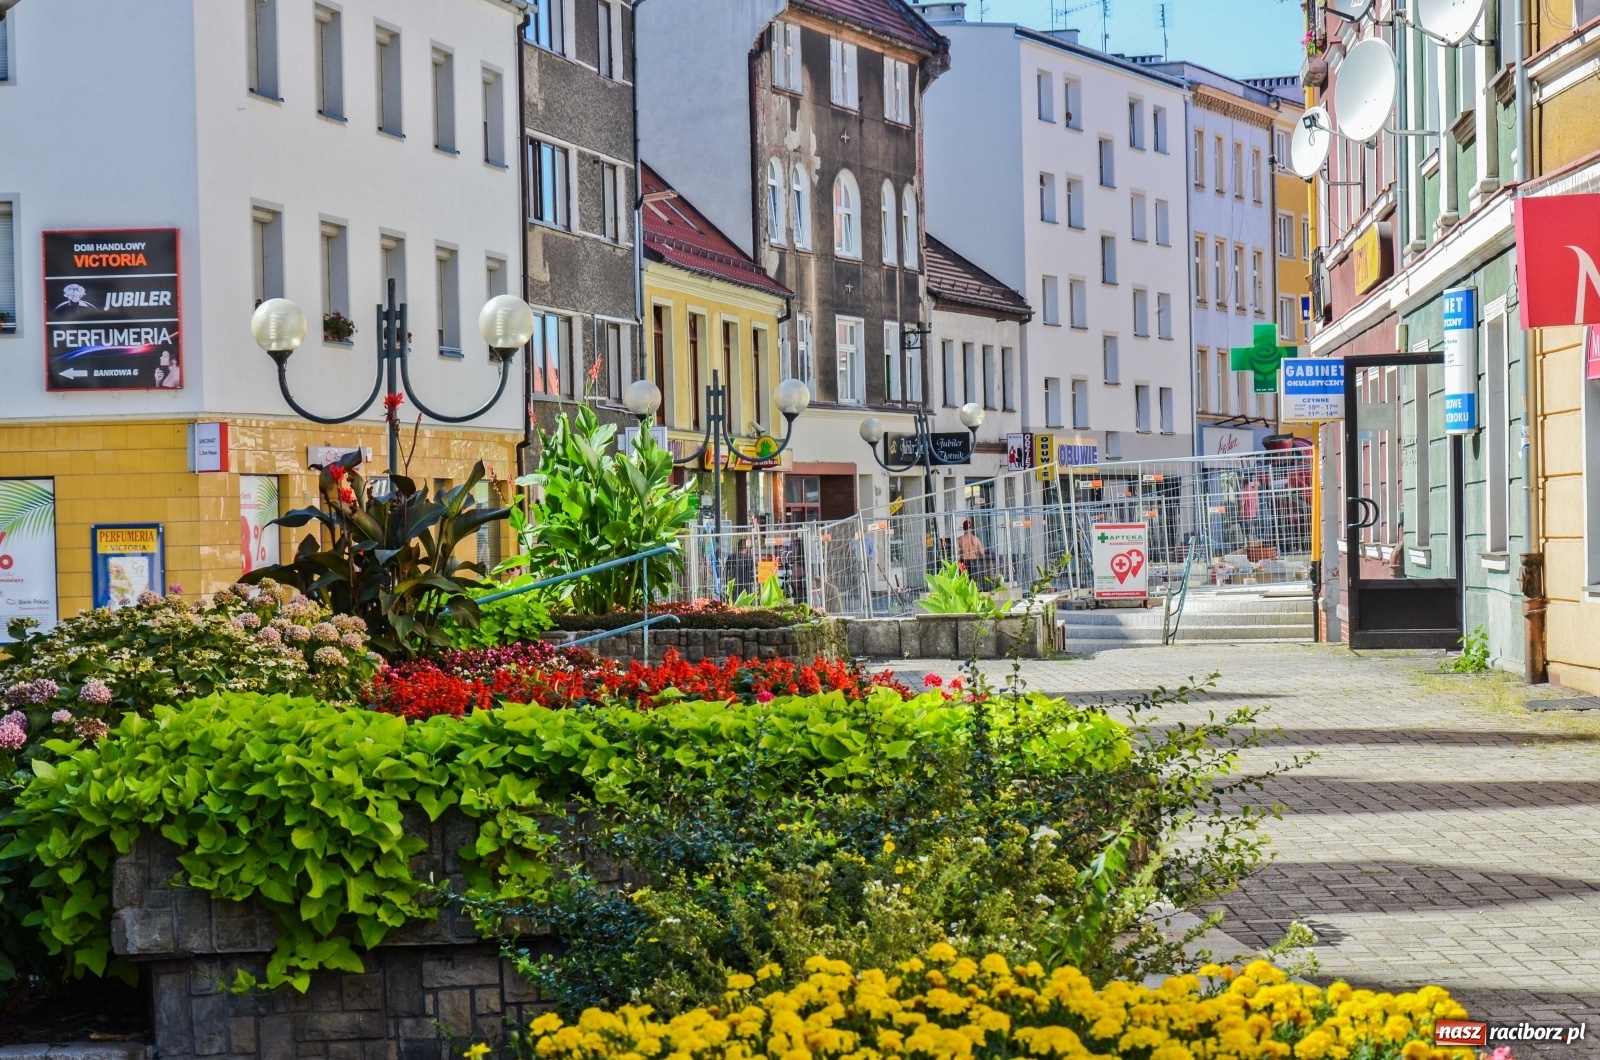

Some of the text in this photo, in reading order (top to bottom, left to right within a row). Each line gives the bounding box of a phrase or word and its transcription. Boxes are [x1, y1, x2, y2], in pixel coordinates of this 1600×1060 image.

[74, 242, 146, 252] DOM HANDLOWY
[74, 253, 147, 268] VICTORIA
[104, 291, 171, 311] JUBILER
[53, 328, 172, 347] PERFUMERIA
[1286, 365, 1344, 377] GABINET
[937, 438, 963, 450] Jubiler
[1059, 444, 1097, 467] OBUWIE
[100, 530, 154, 542] PERFUMERIA
